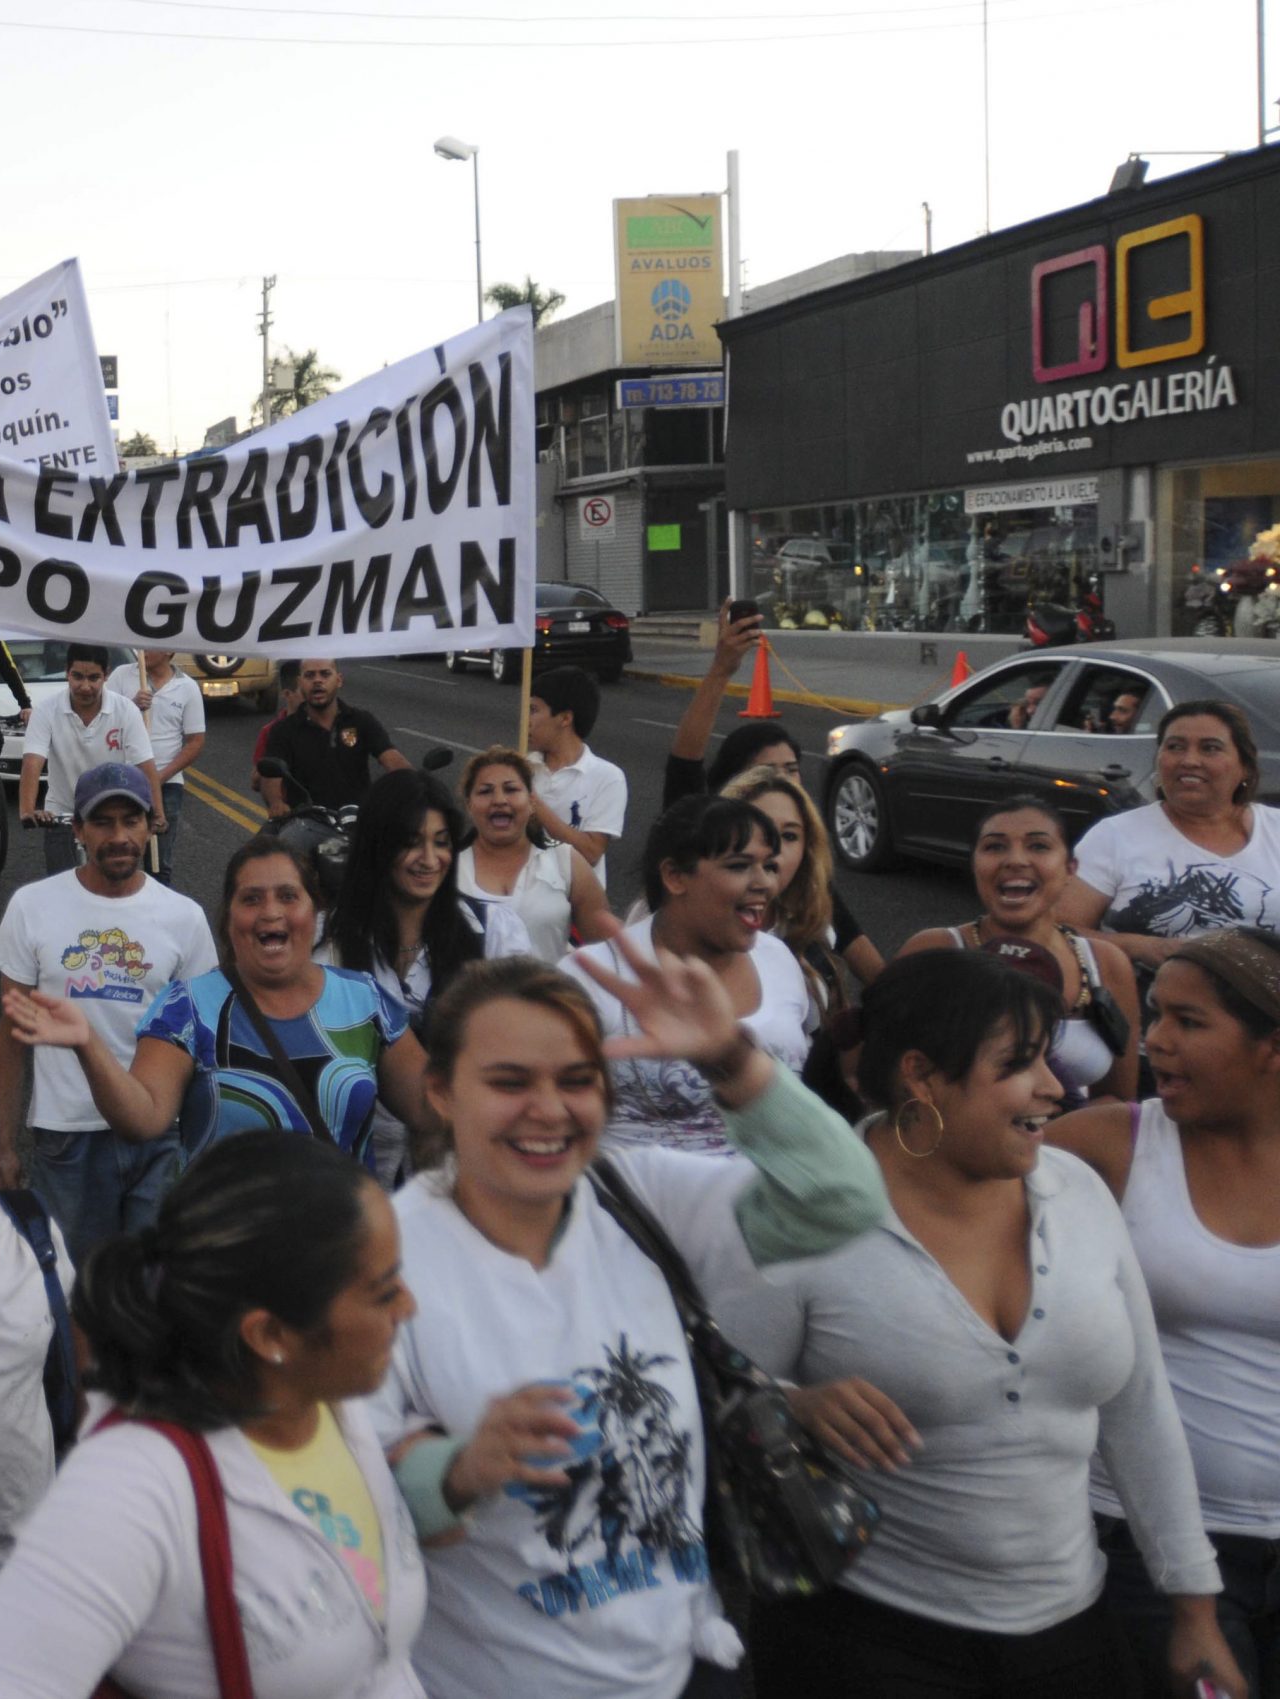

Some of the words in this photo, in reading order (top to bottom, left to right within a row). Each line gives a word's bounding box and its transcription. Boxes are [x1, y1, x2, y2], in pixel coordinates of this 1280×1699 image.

[631, 256, 712, 270] AVALUOS
[650, 324, 694, 341] ADA
[647, 381, 721, 401] 713-78-73
[34, 344, 513, 549] EXTRADICIÓN
[124, 537, 517, 644] GUZMAN
[998, 943, 1032, 959] NY
[517, 1545, 663, 1618] SUPREME
